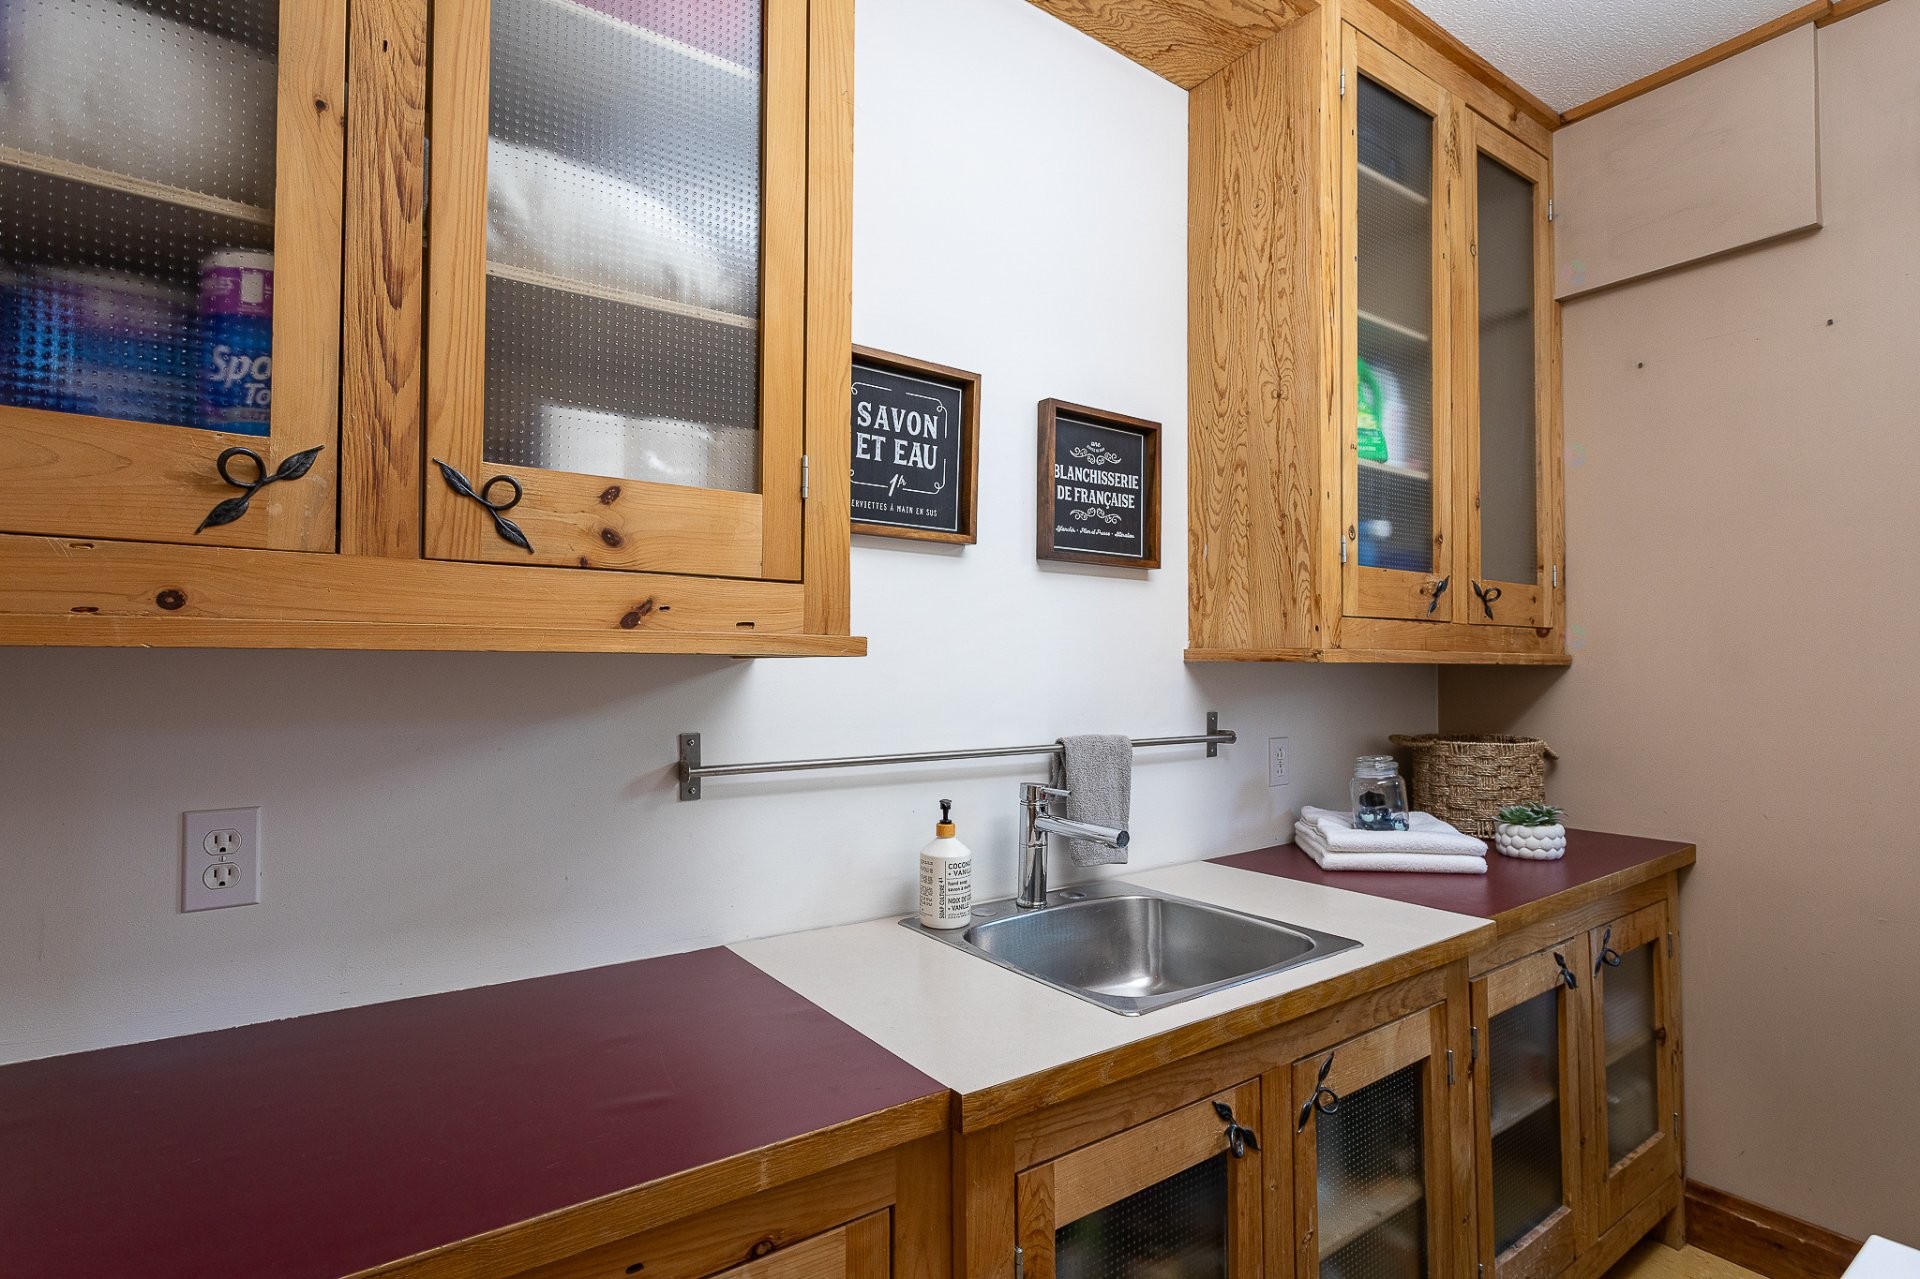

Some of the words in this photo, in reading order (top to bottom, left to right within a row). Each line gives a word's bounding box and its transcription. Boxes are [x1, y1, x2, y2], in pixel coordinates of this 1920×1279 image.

[857, 401, 938, 439] SAVON
[856, 432, 886, 461] ET
[893, 438, 938, 470] EAU
[1054, 463, 1139, 489] BLANCHISSERIE
[1057, 485, 1072, 501] DE
[1074, 487, 1135, 509] FRANÇAISE
[896, 505, 913, 514] MAIN
[926, 508, 938, 517] SUS
